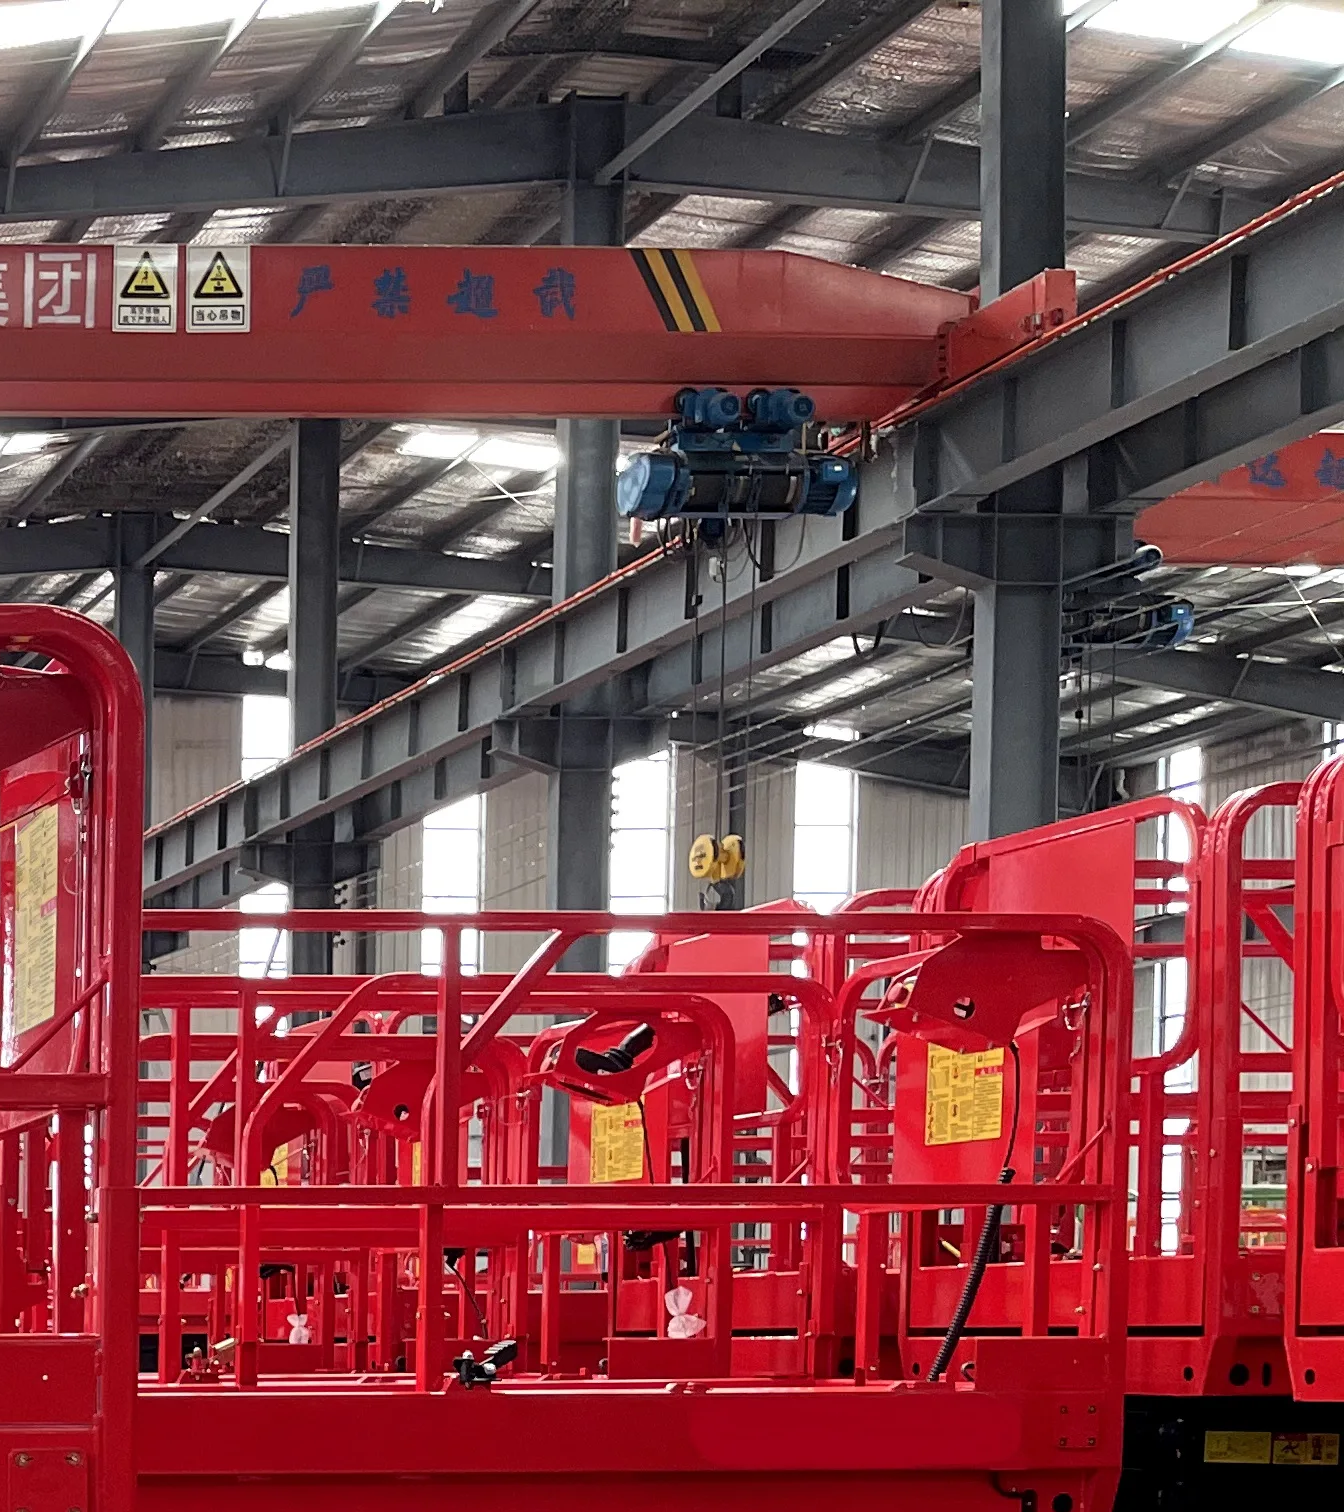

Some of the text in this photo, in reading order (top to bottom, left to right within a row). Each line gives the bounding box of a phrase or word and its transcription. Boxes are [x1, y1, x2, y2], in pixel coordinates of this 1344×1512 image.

[289, 264, 576, 321] 严禁超载
[195, 308, 241, 322] 当心吊物
